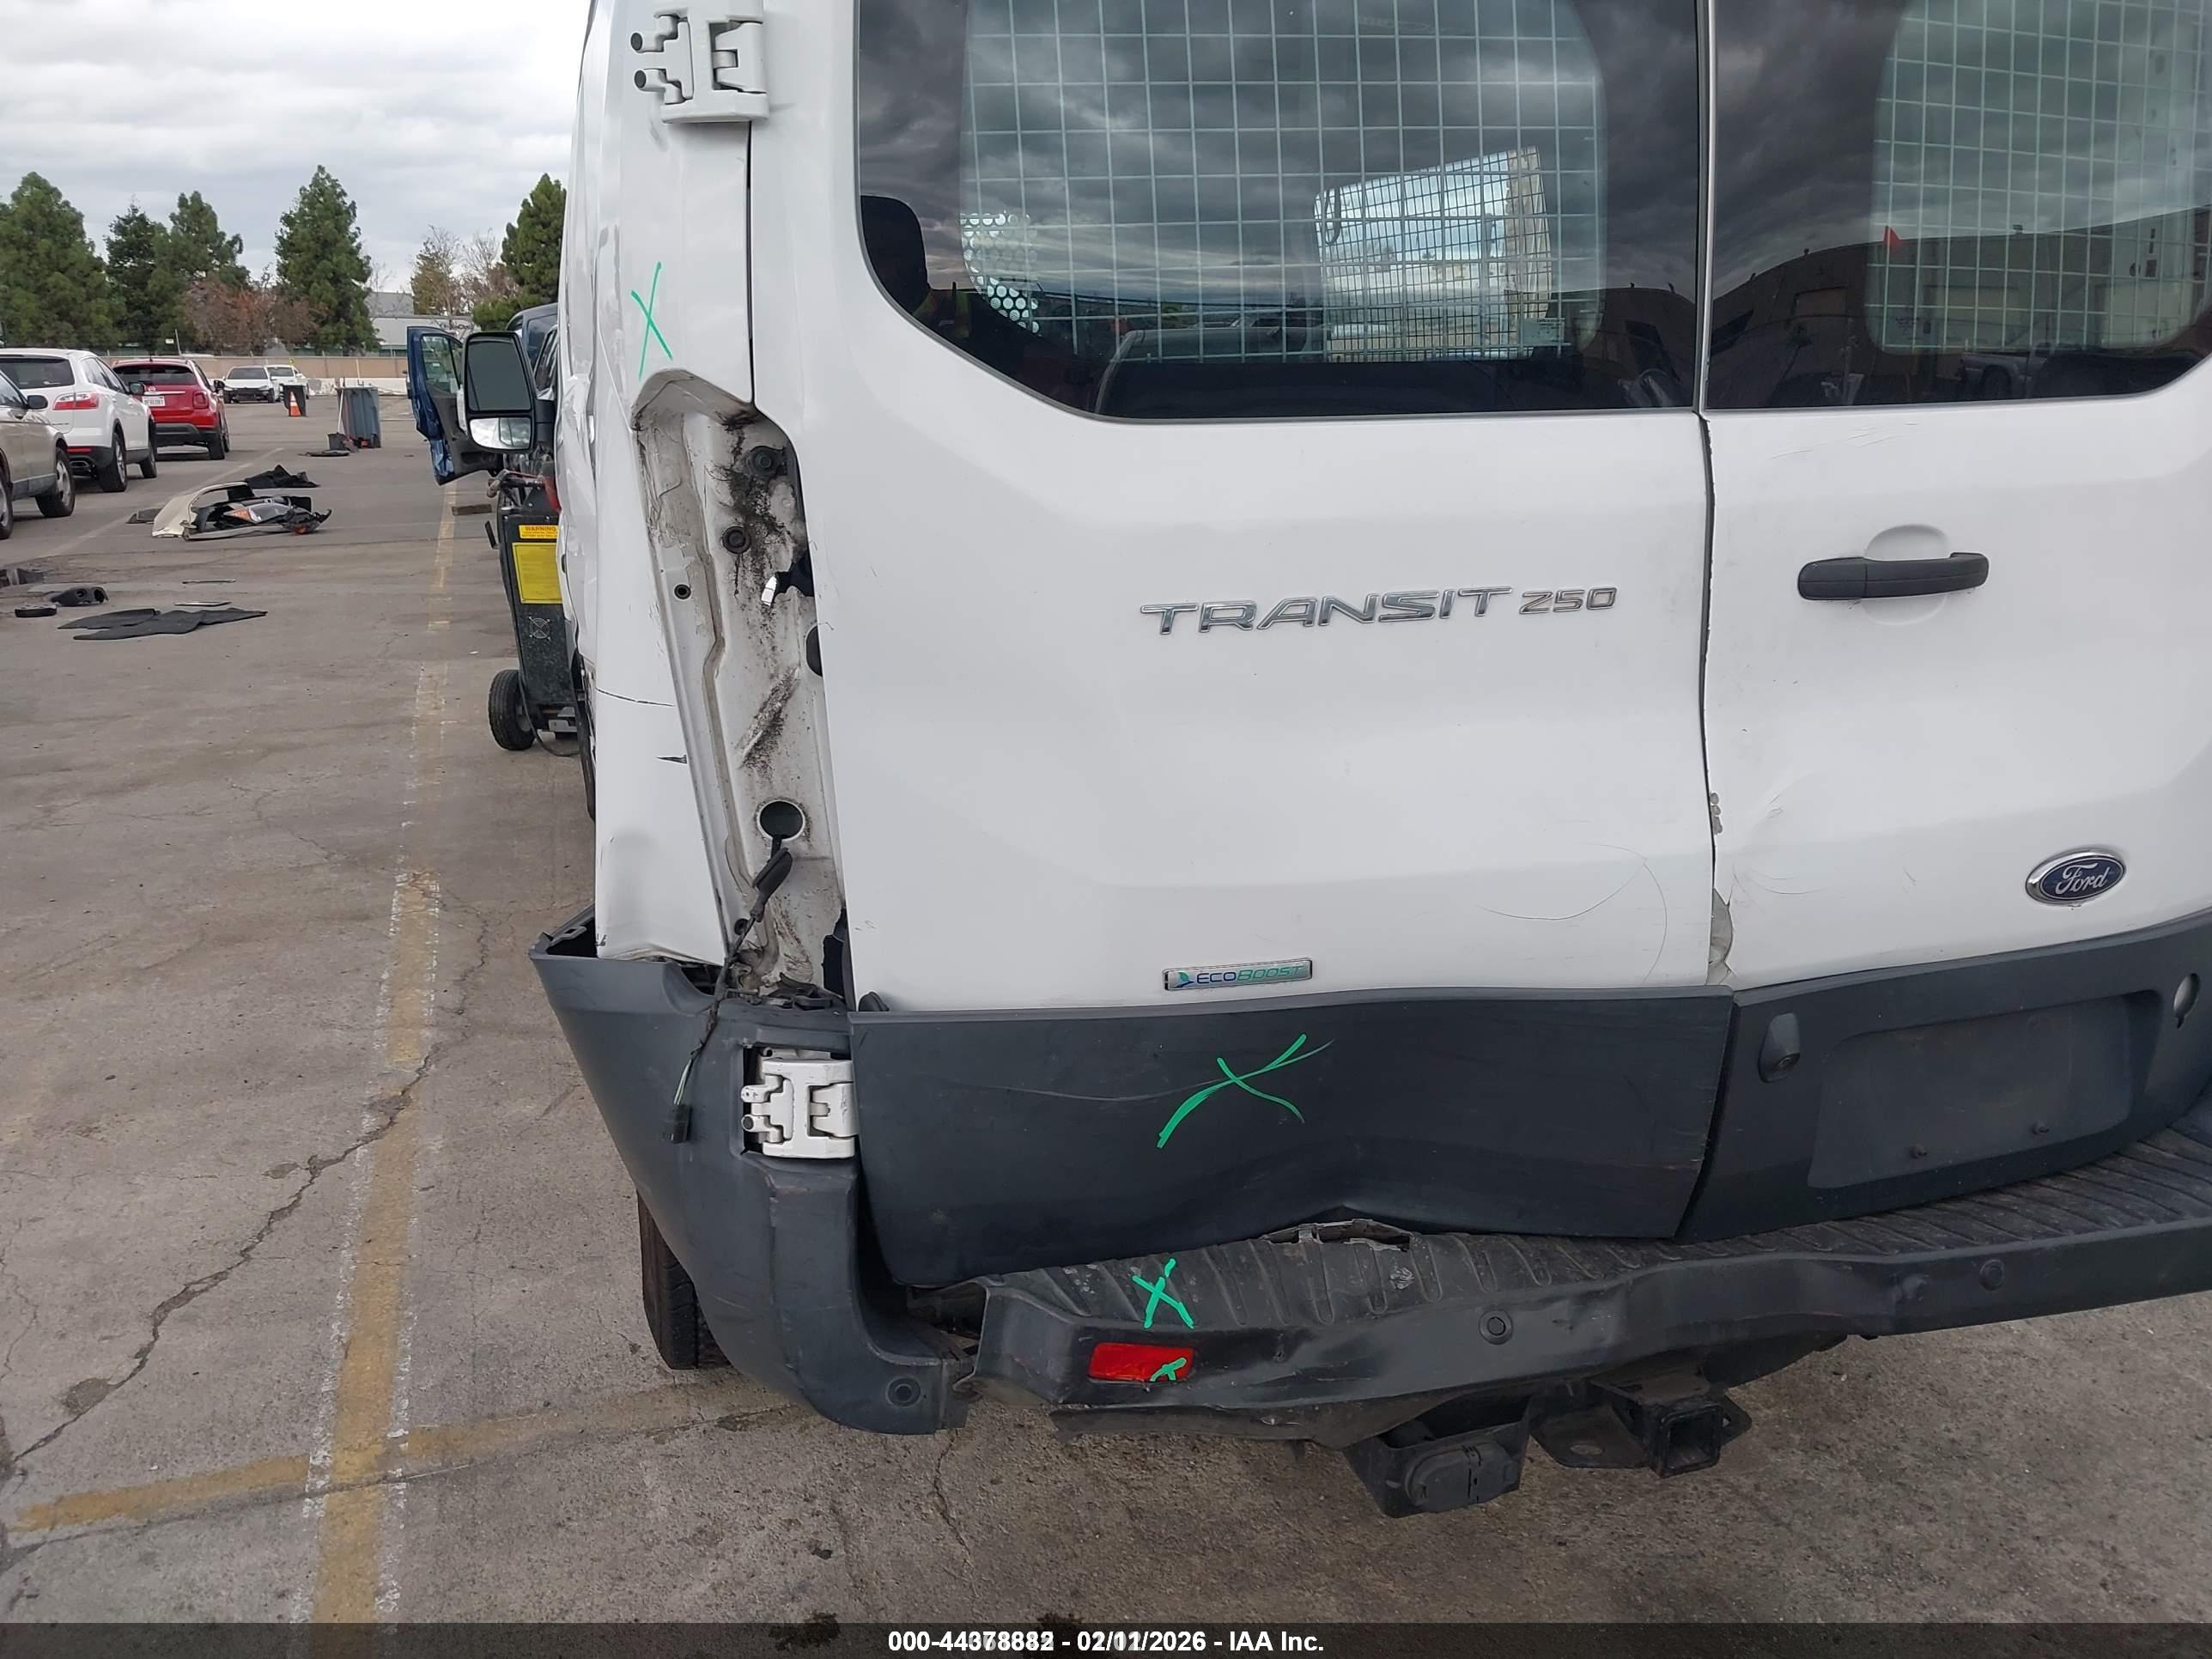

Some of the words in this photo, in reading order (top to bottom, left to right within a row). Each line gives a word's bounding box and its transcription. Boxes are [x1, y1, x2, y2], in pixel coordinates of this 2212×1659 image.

[1139, 586, 1513, 635] TRANSIT
[1519, 586, 1619, 615] 250
[2055, 862, 2111, 895] Ford
[1196, 965, 1305, 984] ECOBOOST
